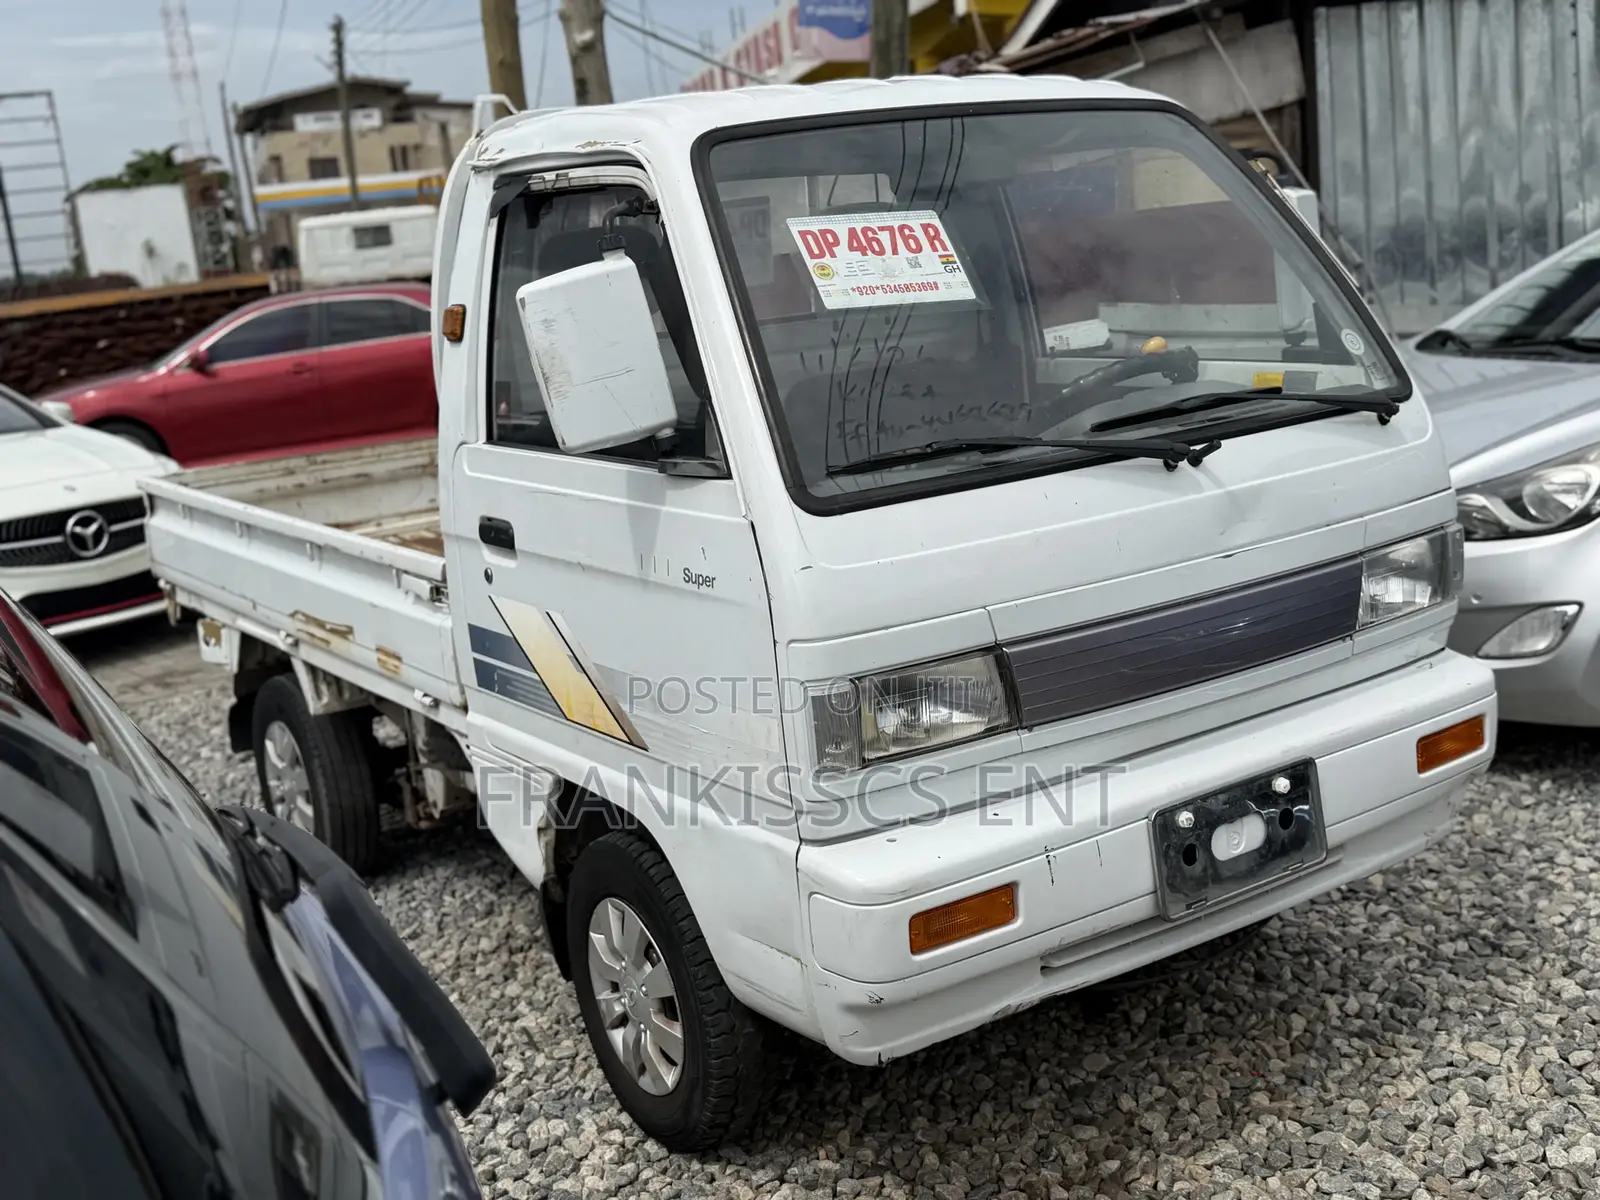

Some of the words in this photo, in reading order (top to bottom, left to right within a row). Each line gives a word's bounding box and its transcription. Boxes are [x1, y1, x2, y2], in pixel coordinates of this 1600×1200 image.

[798, 228, 841, 260] DP
[848, 223, 923, 257] 4676
[920, 223, 949, 253] R
[943, 264, 962, 274] GH
[682, 567, 716, 590] Super
